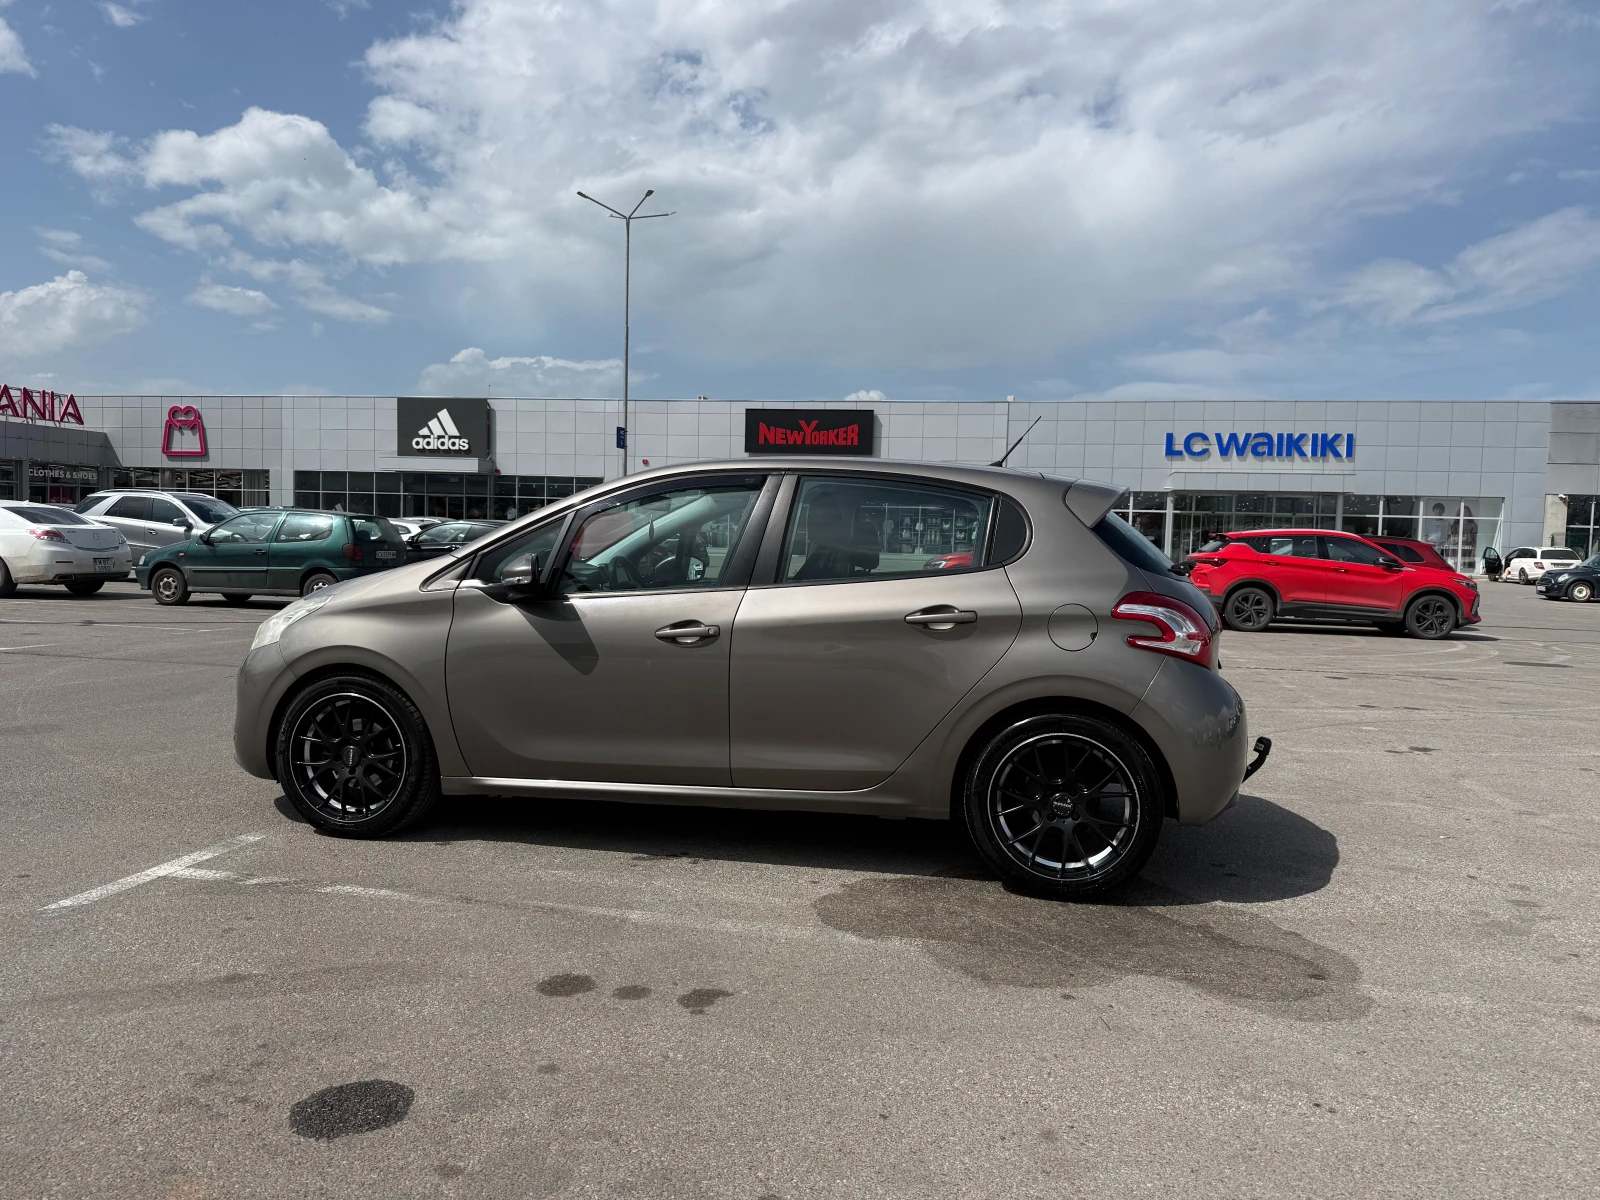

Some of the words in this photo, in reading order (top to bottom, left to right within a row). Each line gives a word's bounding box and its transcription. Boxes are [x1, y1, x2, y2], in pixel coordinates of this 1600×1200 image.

[412, 435, 469, 451] adidas
[1164, 432, 1210, 457] LC
[29, 468, 65, 478] CLOTHES
[65, 471, 71, 479] &
[72, 471, 98, 480] SHOES
